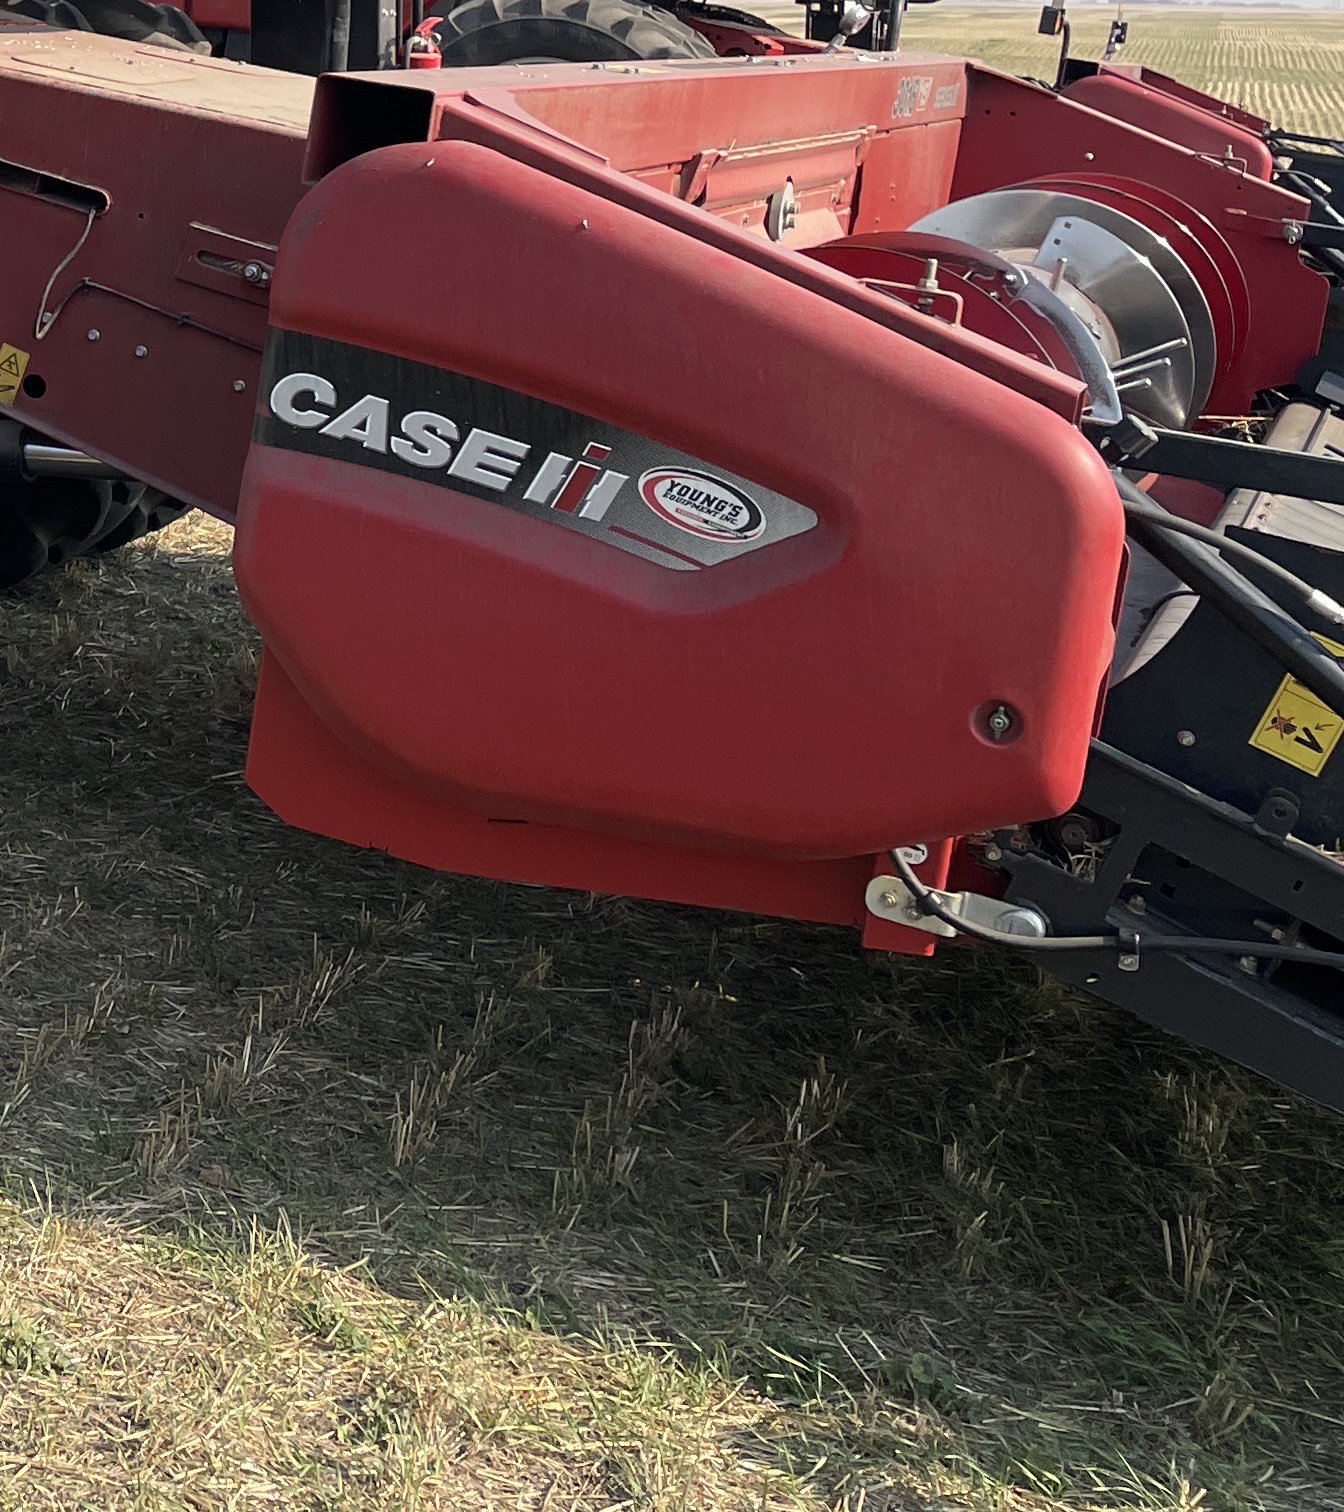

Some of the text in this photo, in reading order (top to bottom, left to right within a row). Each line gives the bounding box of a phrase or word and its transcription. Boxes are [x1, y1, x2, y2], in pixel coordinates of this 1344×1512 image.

[269, 372, 531, 492] CASE
[662, 490, 721, 518] EQUIPMENT
[666, 479, 743, 517] YOUNG'S
